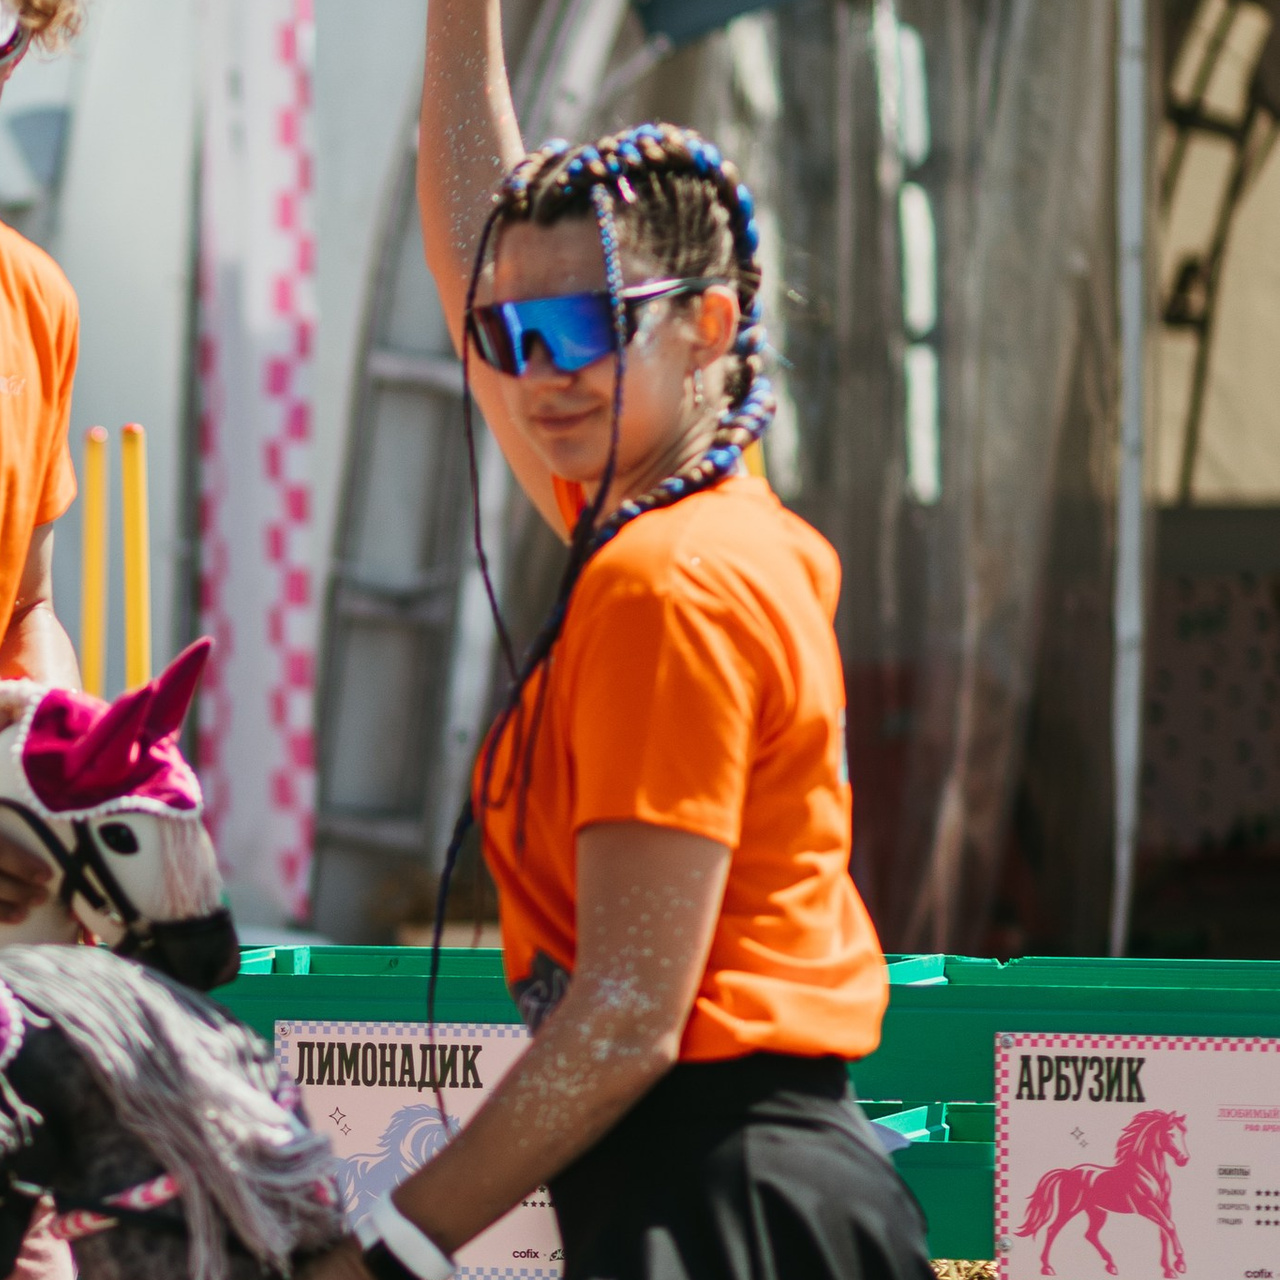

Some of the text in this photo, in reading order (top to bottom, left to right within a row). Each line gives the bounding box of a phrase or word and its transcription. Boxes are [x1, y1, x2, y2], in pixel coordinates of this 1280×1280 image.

[295, 1041, 483, 1093] ЛИМОНАДИК
[1015, 1054, 1146, 1103] АРБУЗИК
[512, 1249, 540, 1259] cofix
[1245, 1269, 1273, 1279] cofix
